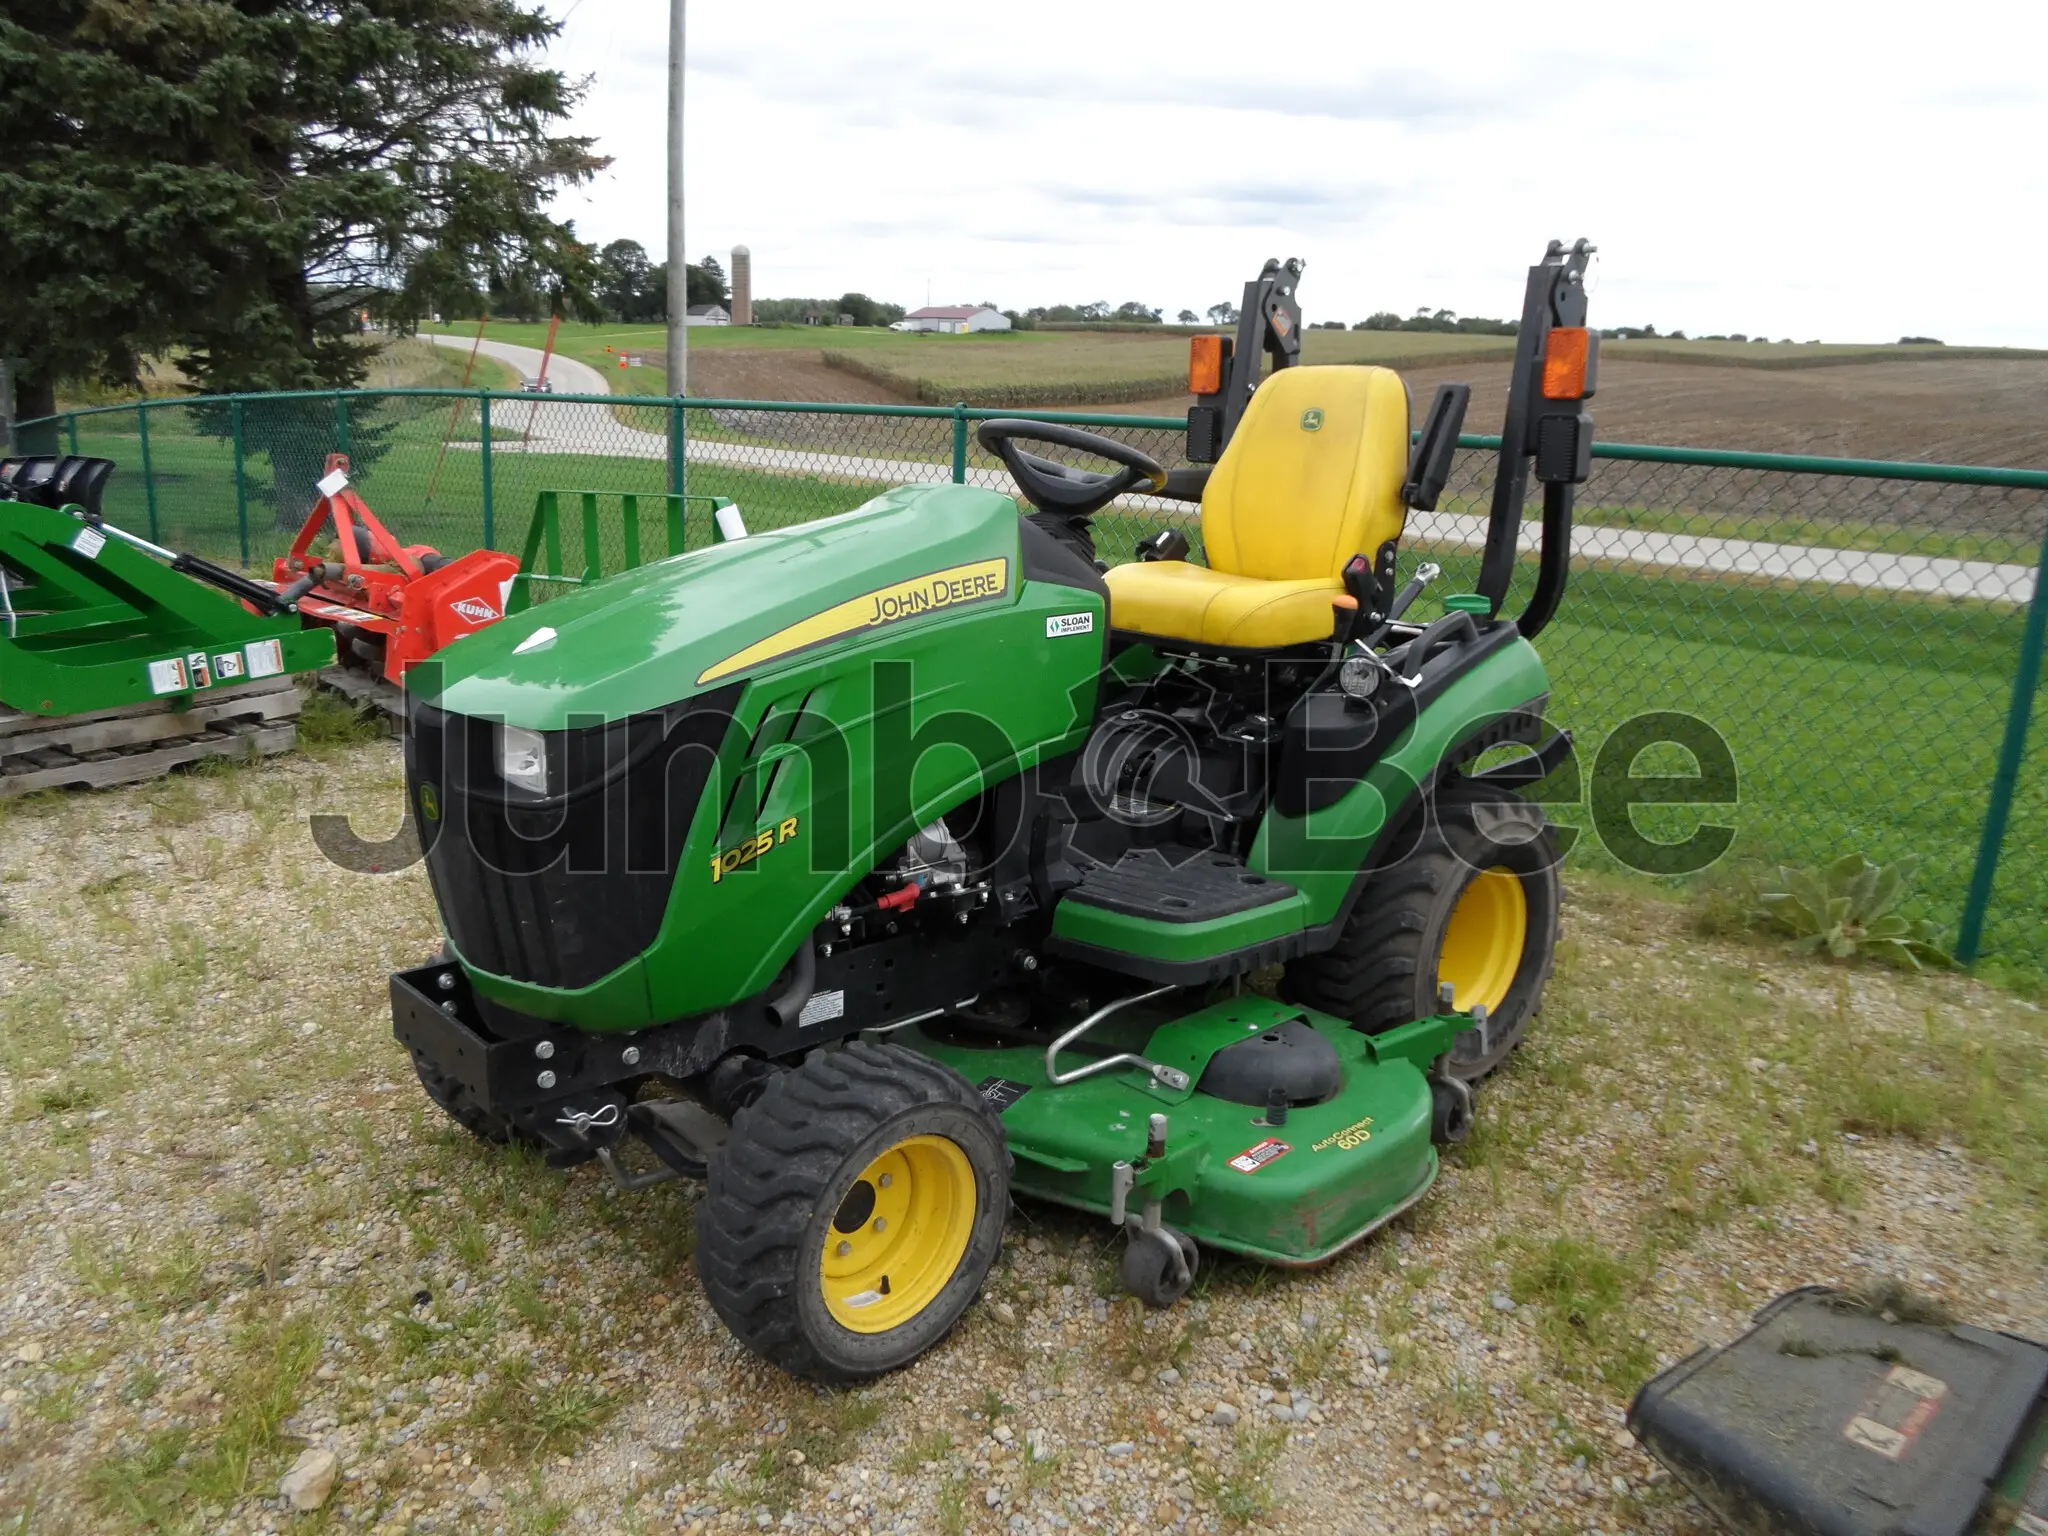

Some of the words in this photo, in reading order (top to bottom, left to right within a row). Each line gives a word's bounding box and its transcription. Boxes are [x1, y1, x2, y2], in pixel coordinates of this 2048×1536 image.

[869, 588, 930, 623] JOHN
[932, 573, 998, 603] DEERE
[457, 602, 493, 618] KUHN
[1060, 624, 1090, 633] IMPLEMENT
[1061, 615, 1090, 627] SLOAN
[1311, 1116, 1375, 1152] AutoConnect
[1337, 1129, 1371, 1150] 60D
